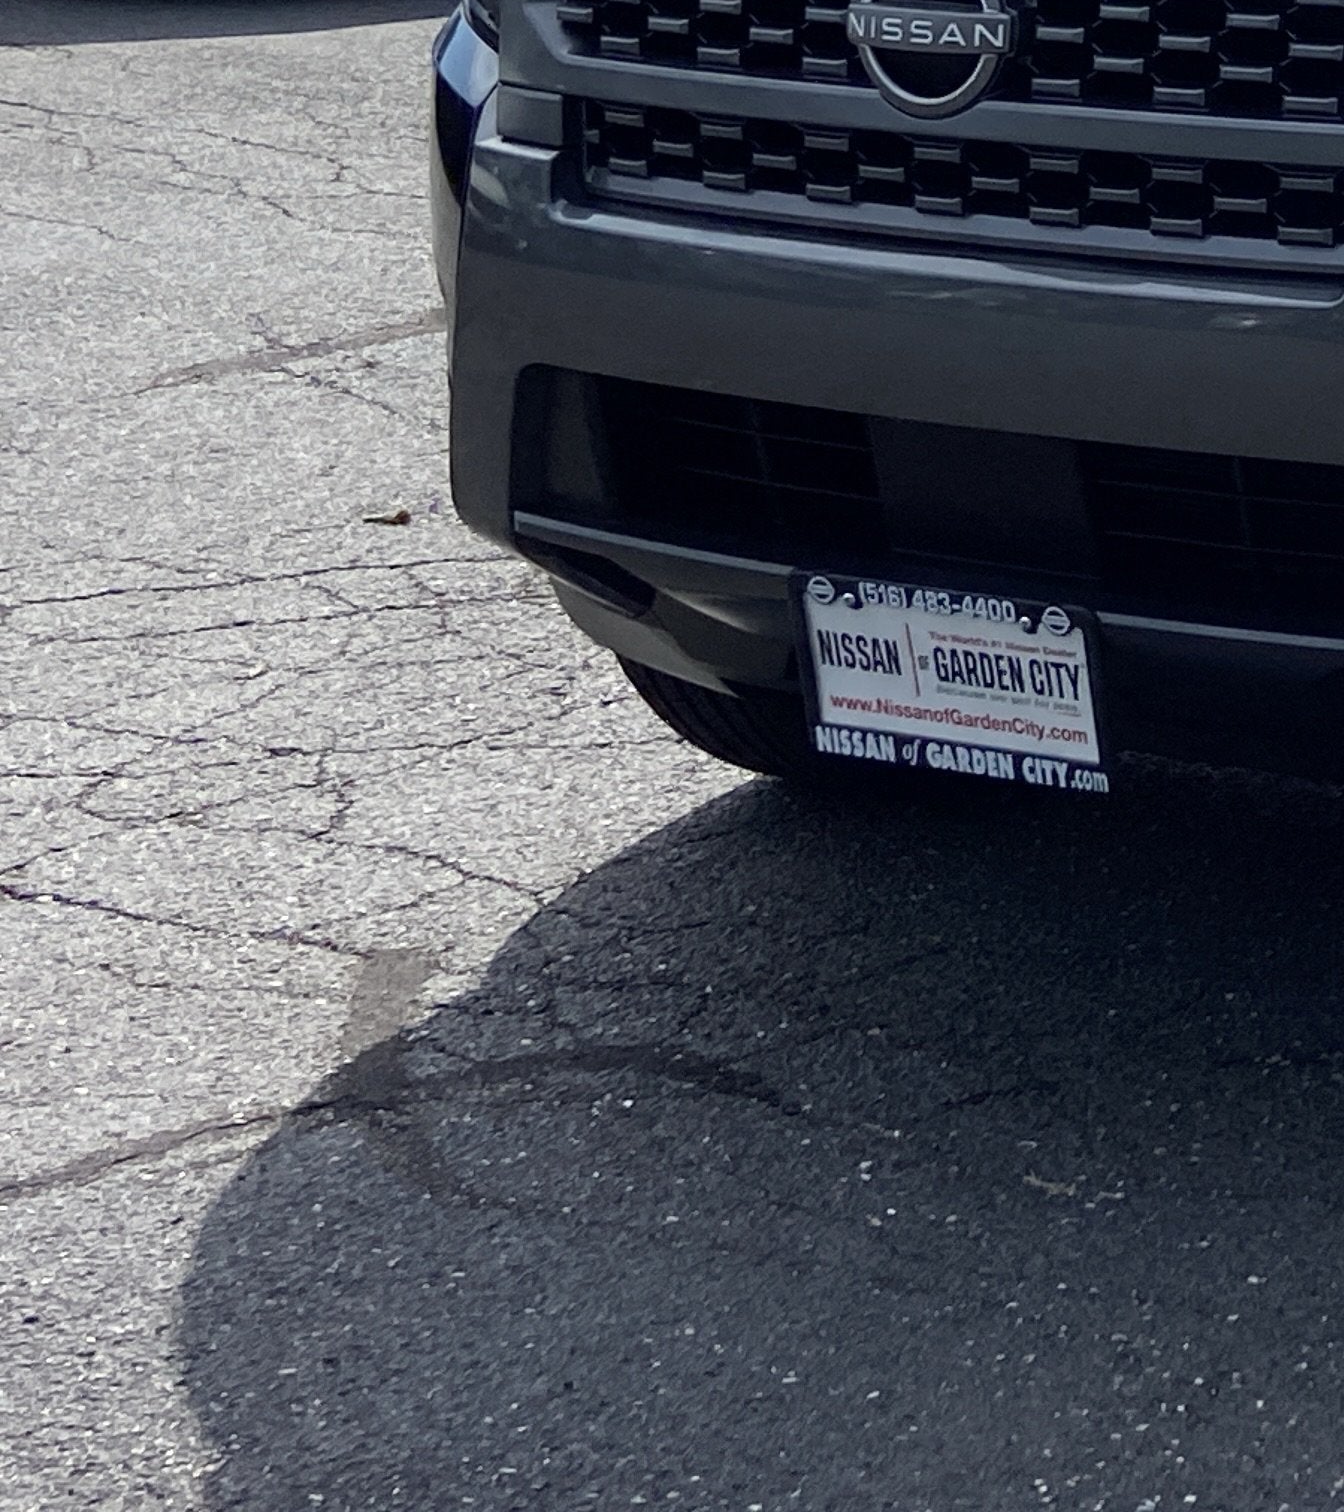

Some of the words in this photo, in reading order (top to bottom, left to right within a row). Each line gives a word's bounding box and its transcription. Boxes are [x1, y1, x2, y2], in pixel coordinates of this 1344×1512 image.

[848, 12, 1004, 48] NISSAN
[858, 581, 907, 608] (516)
[912, 589, 1016, 623] 483-4400
[817, 629, 902, 676] NISSAN
[918, 654, 930, 670] OF
[934, 647, 1024, 694] GARDEN
[1031, 659, 1081, 701] CITY
[830, 693, 1088, 744] www.NissanofGardenCity.com
[815, 726, 896, 763] NISSAN
[902, 739, 921, 765] of
[926, 742, 1014, 780] GARDEN
